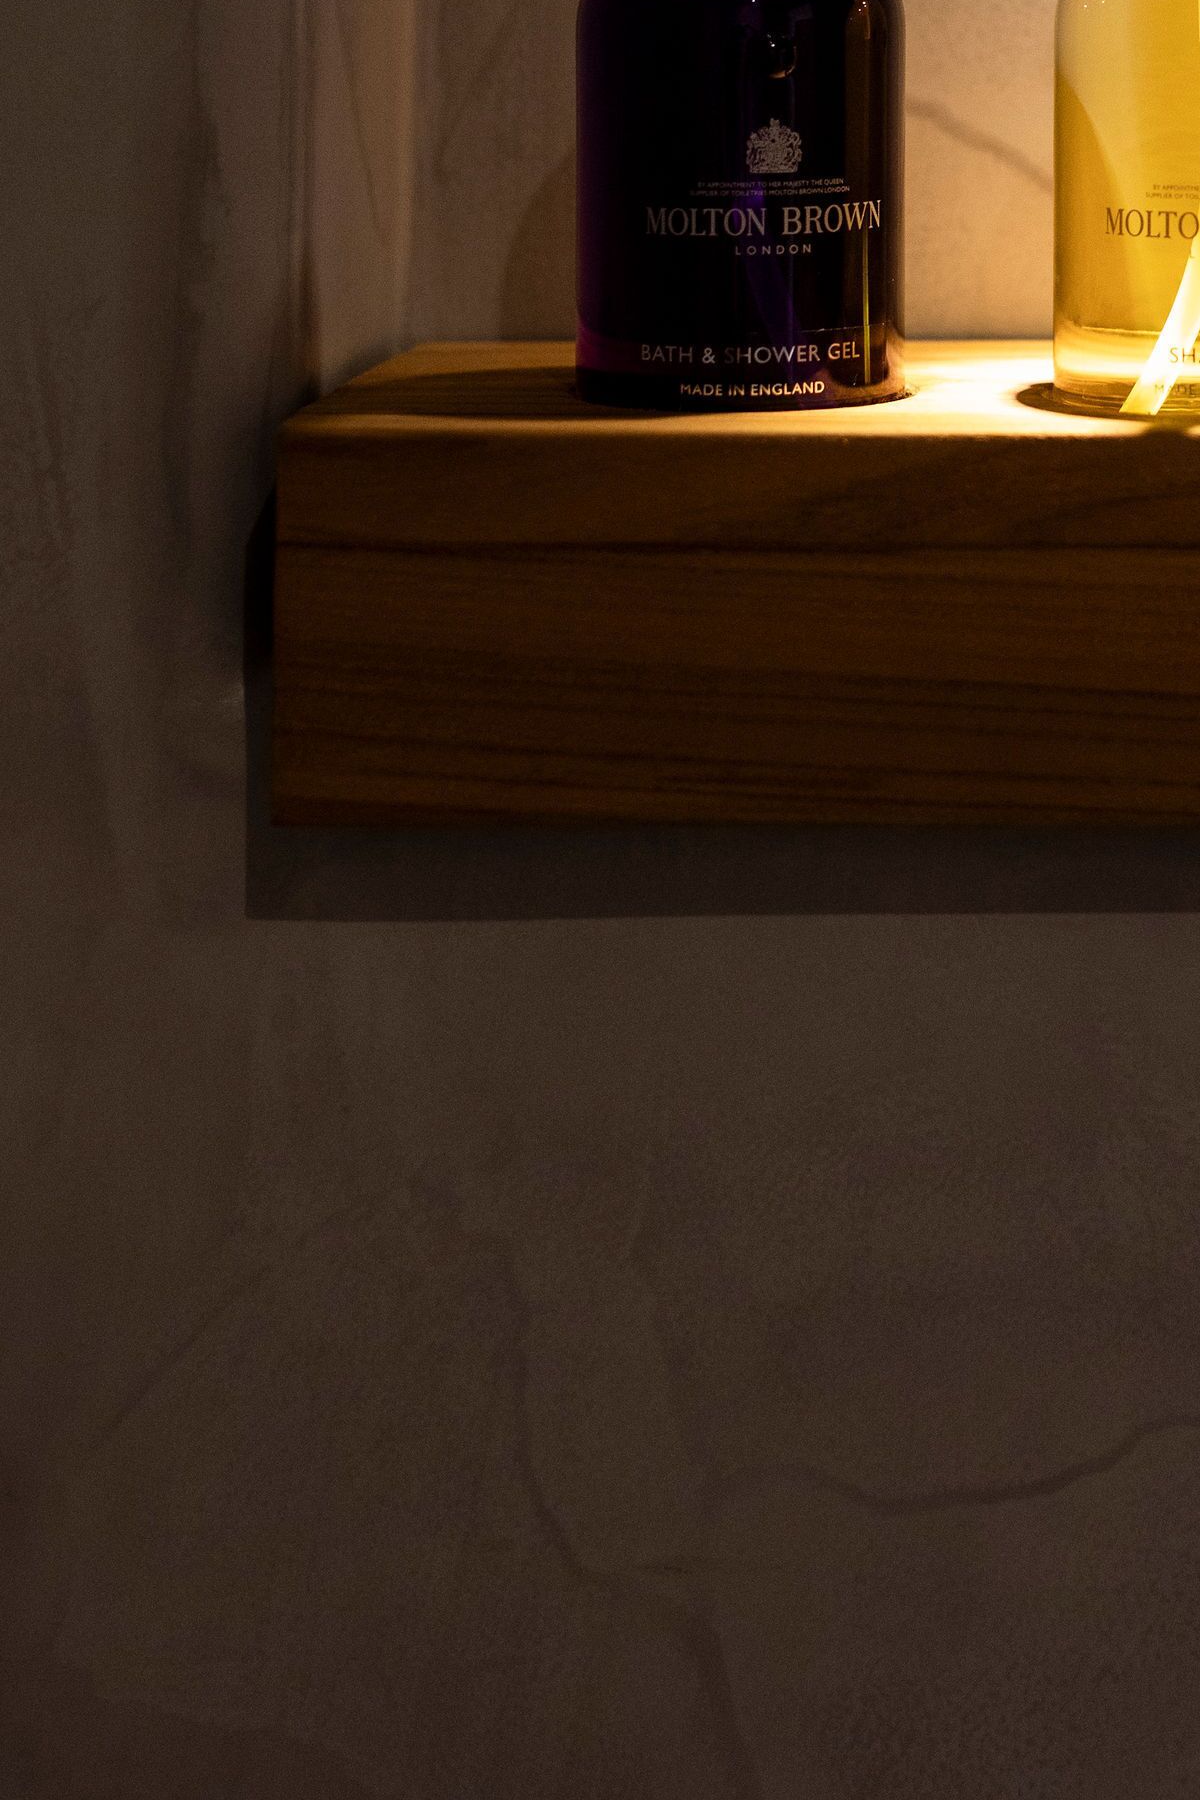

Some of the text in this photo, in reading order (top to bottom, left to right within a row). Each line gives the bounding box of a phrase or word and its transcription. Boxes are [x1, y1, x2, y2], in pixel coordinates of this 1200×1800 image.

[824, 178, 844, 186] QUEEN
[824, 186, 850, 194] LONDON
[646, 200, 882, 236] MOLTON BROWN
[735, 244, 812, 256] LONDON
[641, 341, 860, 364] BATH & SHOWER GEL
[680, 381, 825, 396] MADE IN ENGLAND
